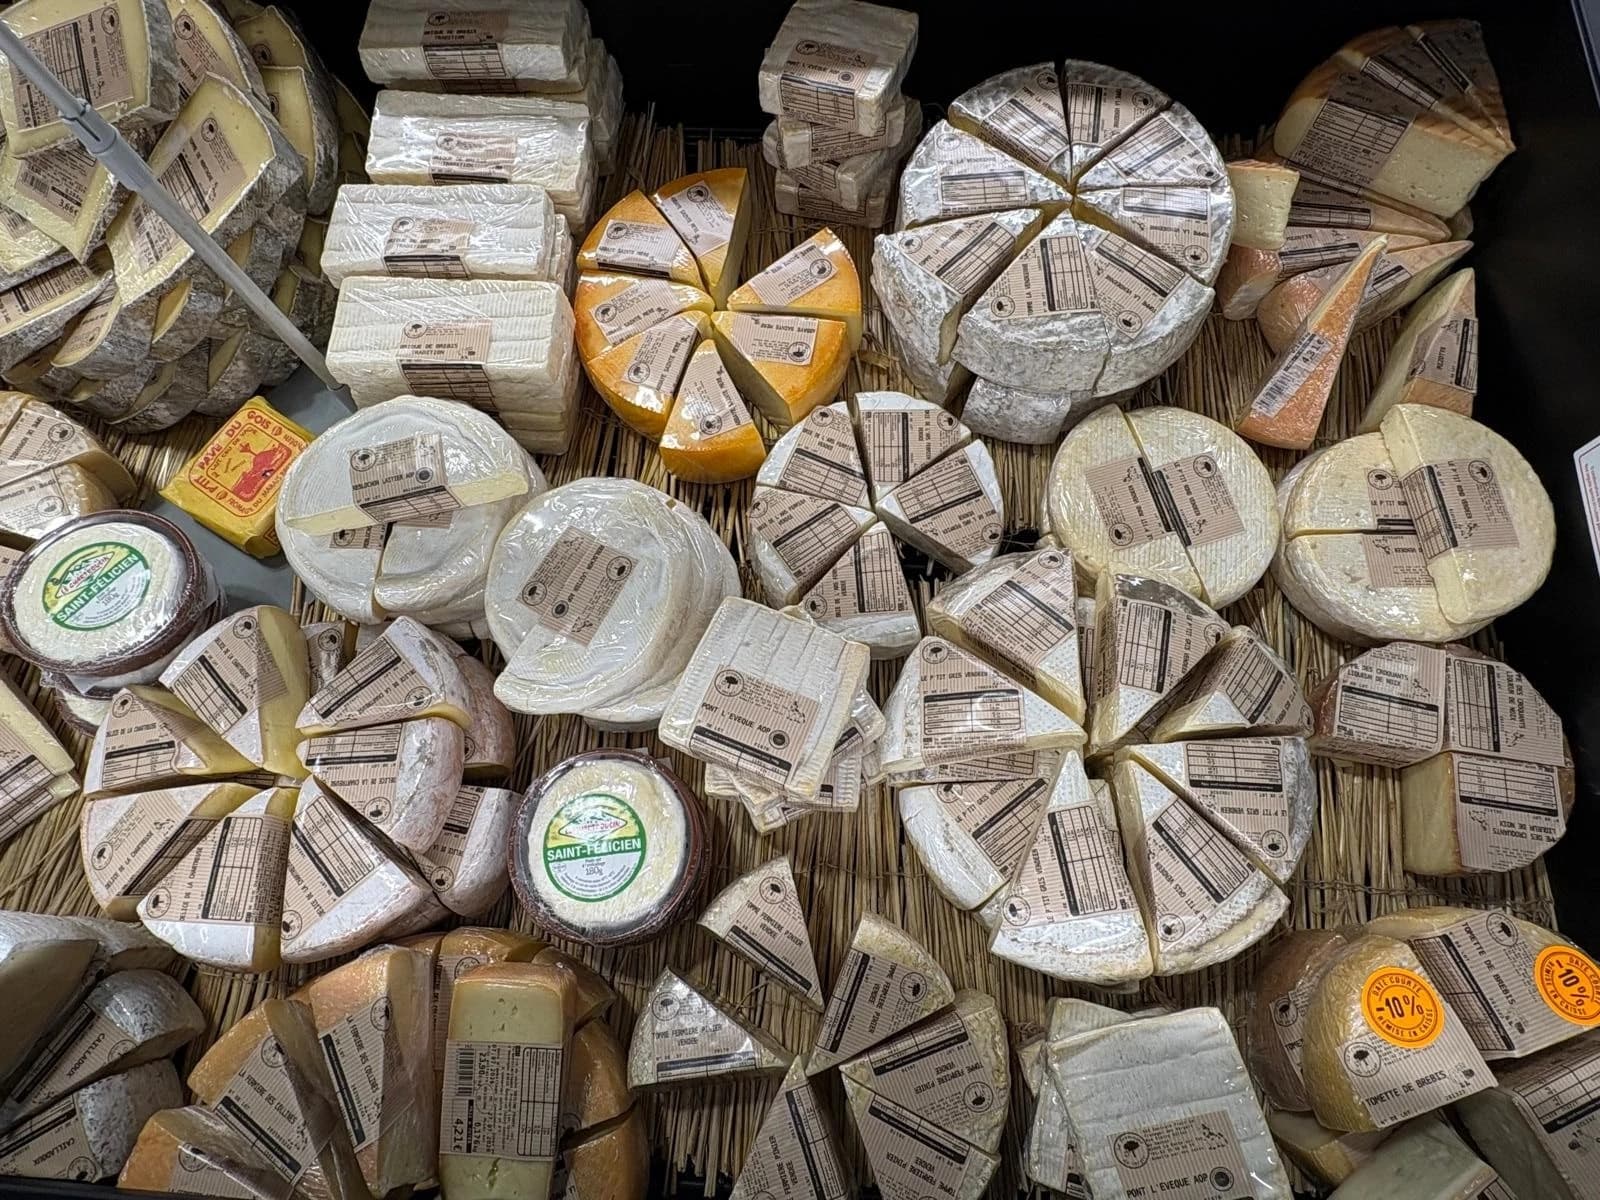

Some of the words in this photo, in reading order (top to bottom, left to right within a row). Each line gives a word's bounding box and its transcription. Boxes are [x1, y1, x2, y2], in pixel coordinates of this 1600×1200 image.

[225, 420, 242, 438] DU
[246, 410, 270, 429] GOIS
[252, 498, 262, 507] DU
[53, 551, 140, 622] SAINT-FÉLICIEN
[701, 701, 718, 713] PONT
[756, 724, 771, 735] AOP
[1461, 921, 1486, 956] TOMETTE
[1483, 958, 1495, 971] DE
[1492, 972, 1516, 1006] BREBIS
[1569, 956, 1590, 971] DATE
[1372, 978, 1388, 996] DATE
[1390, 975, 1420, 993] COURTE
[1556, 959, 1590, 1006] -10%
[1376, 994, 1424, 1018] -10%
[1559, 1000, 1586, 1015] CAISSE
[1378, 1015, 1404, 1036] REMISE
[1420, 1008, 1432, 1032] CAISSE
[64, 1031, 107, 1078] CAILLADOUX
[1366, 1086, 1401, 1107] TOMETTE
[1401, 1081, 1415, 1094] DE
[1415, 1069, 1447, 1088] BREBIS
[1126, 1187, 1146, 1198] PONT
[1193, 1173, 1209, 1183] AOP
